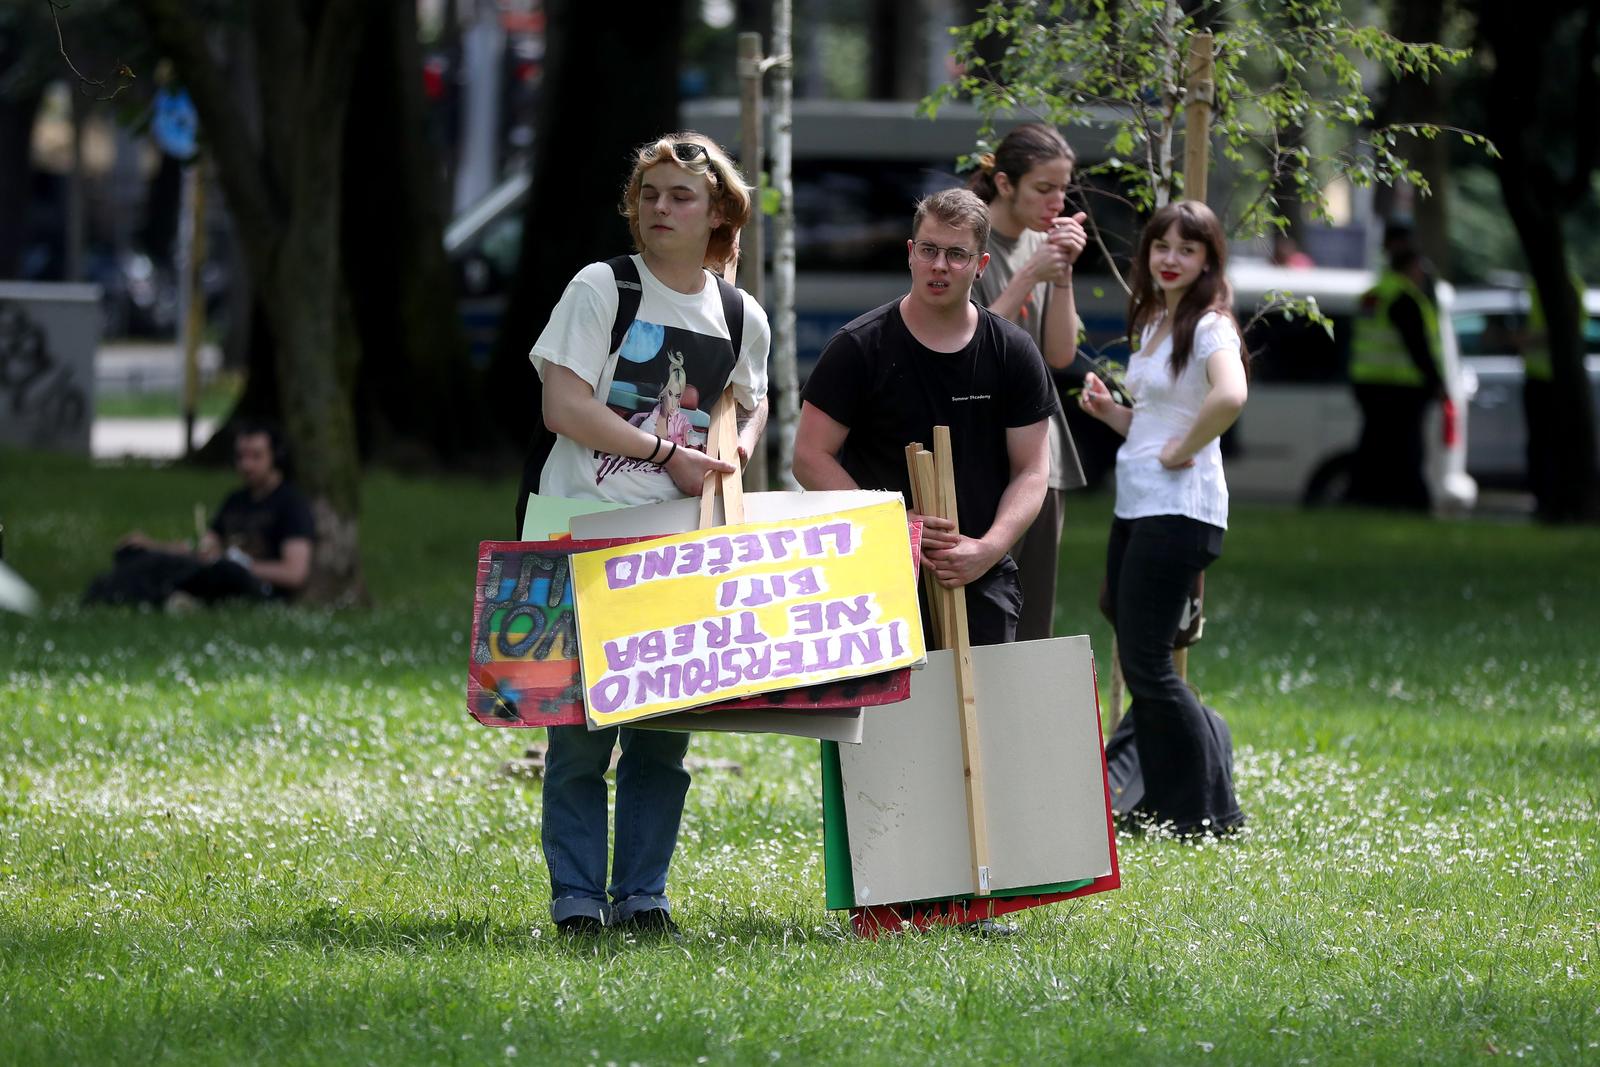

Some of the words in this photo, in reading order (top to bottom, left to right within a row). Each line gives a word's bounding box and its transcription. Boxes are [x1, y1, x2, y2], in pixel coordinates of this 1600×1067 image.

[604, 522, 851, 590] LIJEČENO
[719, 567, 821, 608] BITI
[789, 594, 871, 635] NE
[589, 621, 904, 714] INTERSPOLNO
[603, 611, 767, 672] TREBA
